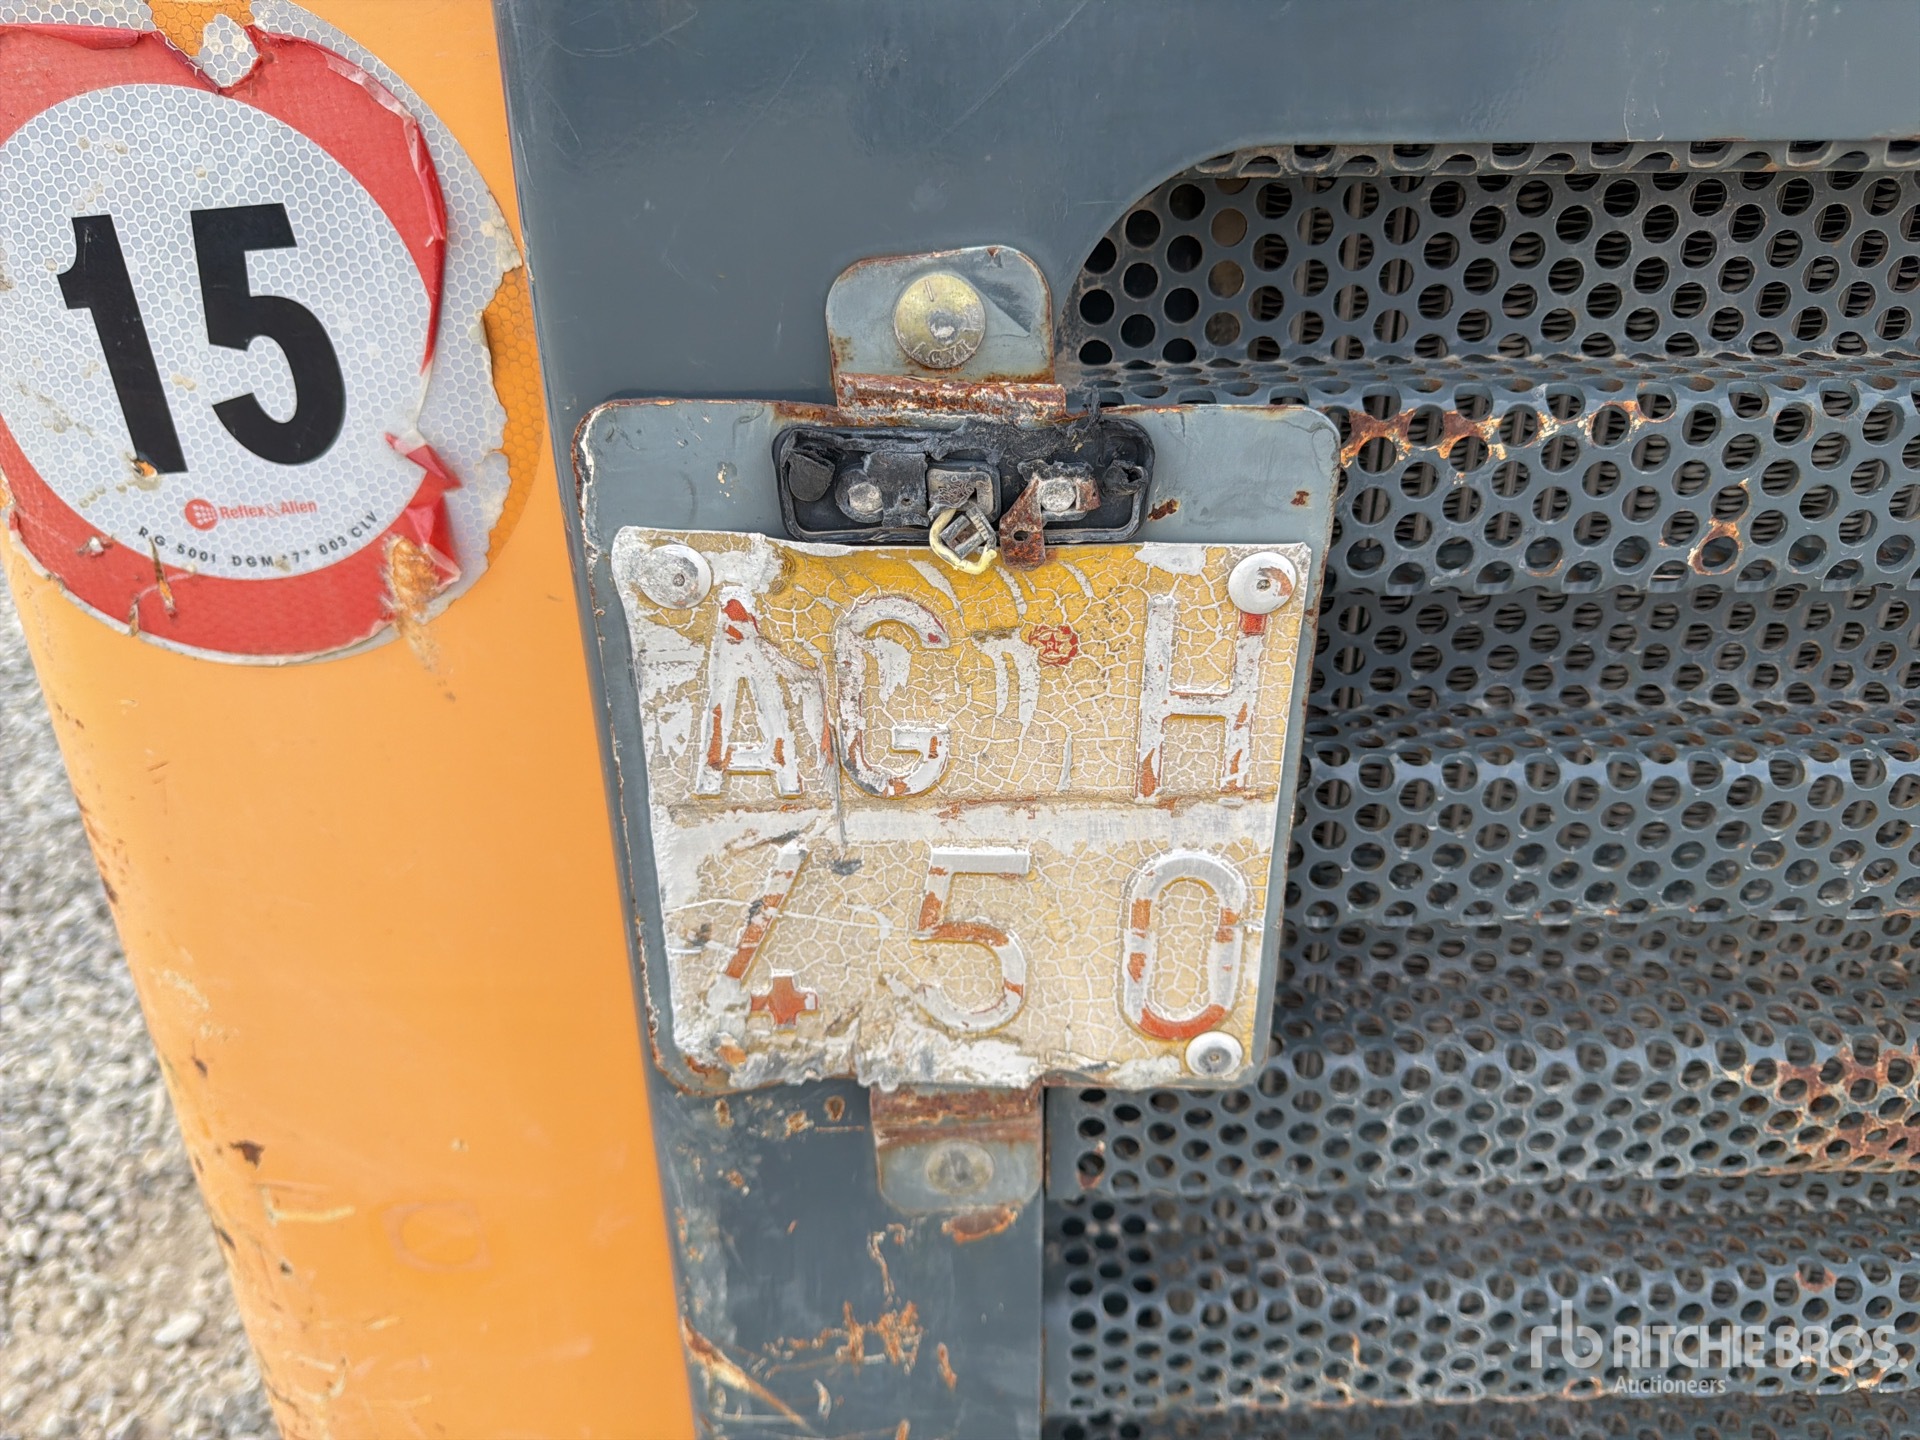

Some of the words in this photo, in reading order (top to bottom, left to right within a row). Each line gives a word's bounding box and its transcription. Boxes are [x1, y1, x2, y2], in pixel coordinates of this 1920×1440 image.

[57, 203, 347, 473] 15
[176, 543, 217, 563] 5001
[231, 555, 274, 567] DGM
[319, 536, 348, 555] 003
[1136, 594, 1266, 800] H
